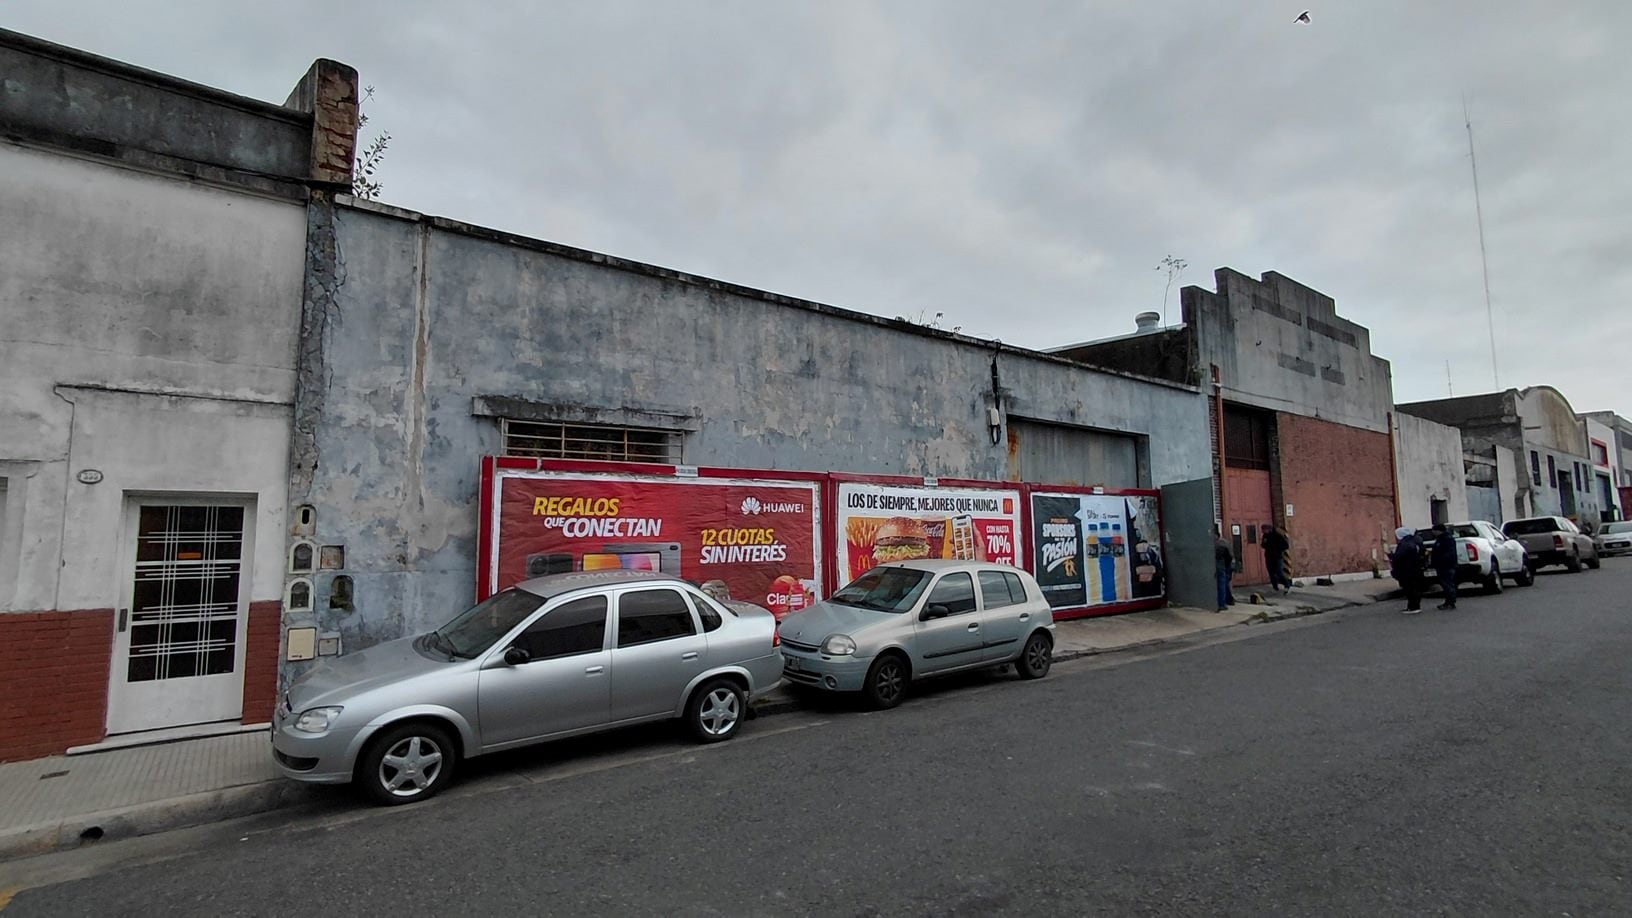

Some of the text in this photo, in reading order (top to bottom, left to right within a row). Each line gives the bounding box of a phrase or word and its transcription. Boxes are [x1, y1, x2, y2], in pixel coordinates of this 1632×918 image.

[532, 496, 620, 516] REGALOS
[763, 503, 804, 513] HUAWEI
[847, 492, 998, 513] LOS DE SIEMPRE, MEJORES QUE NUNCA
[543, 517, 662, 537] QUE CONECTAN
[701, 528, 774, 545] 12 CUOTAS
[700, 540, 787, 564] SIN INTERÉS
[987, 534, 1011, 554] 70%
[1041, 537, 1077, 566] PASIÓN
